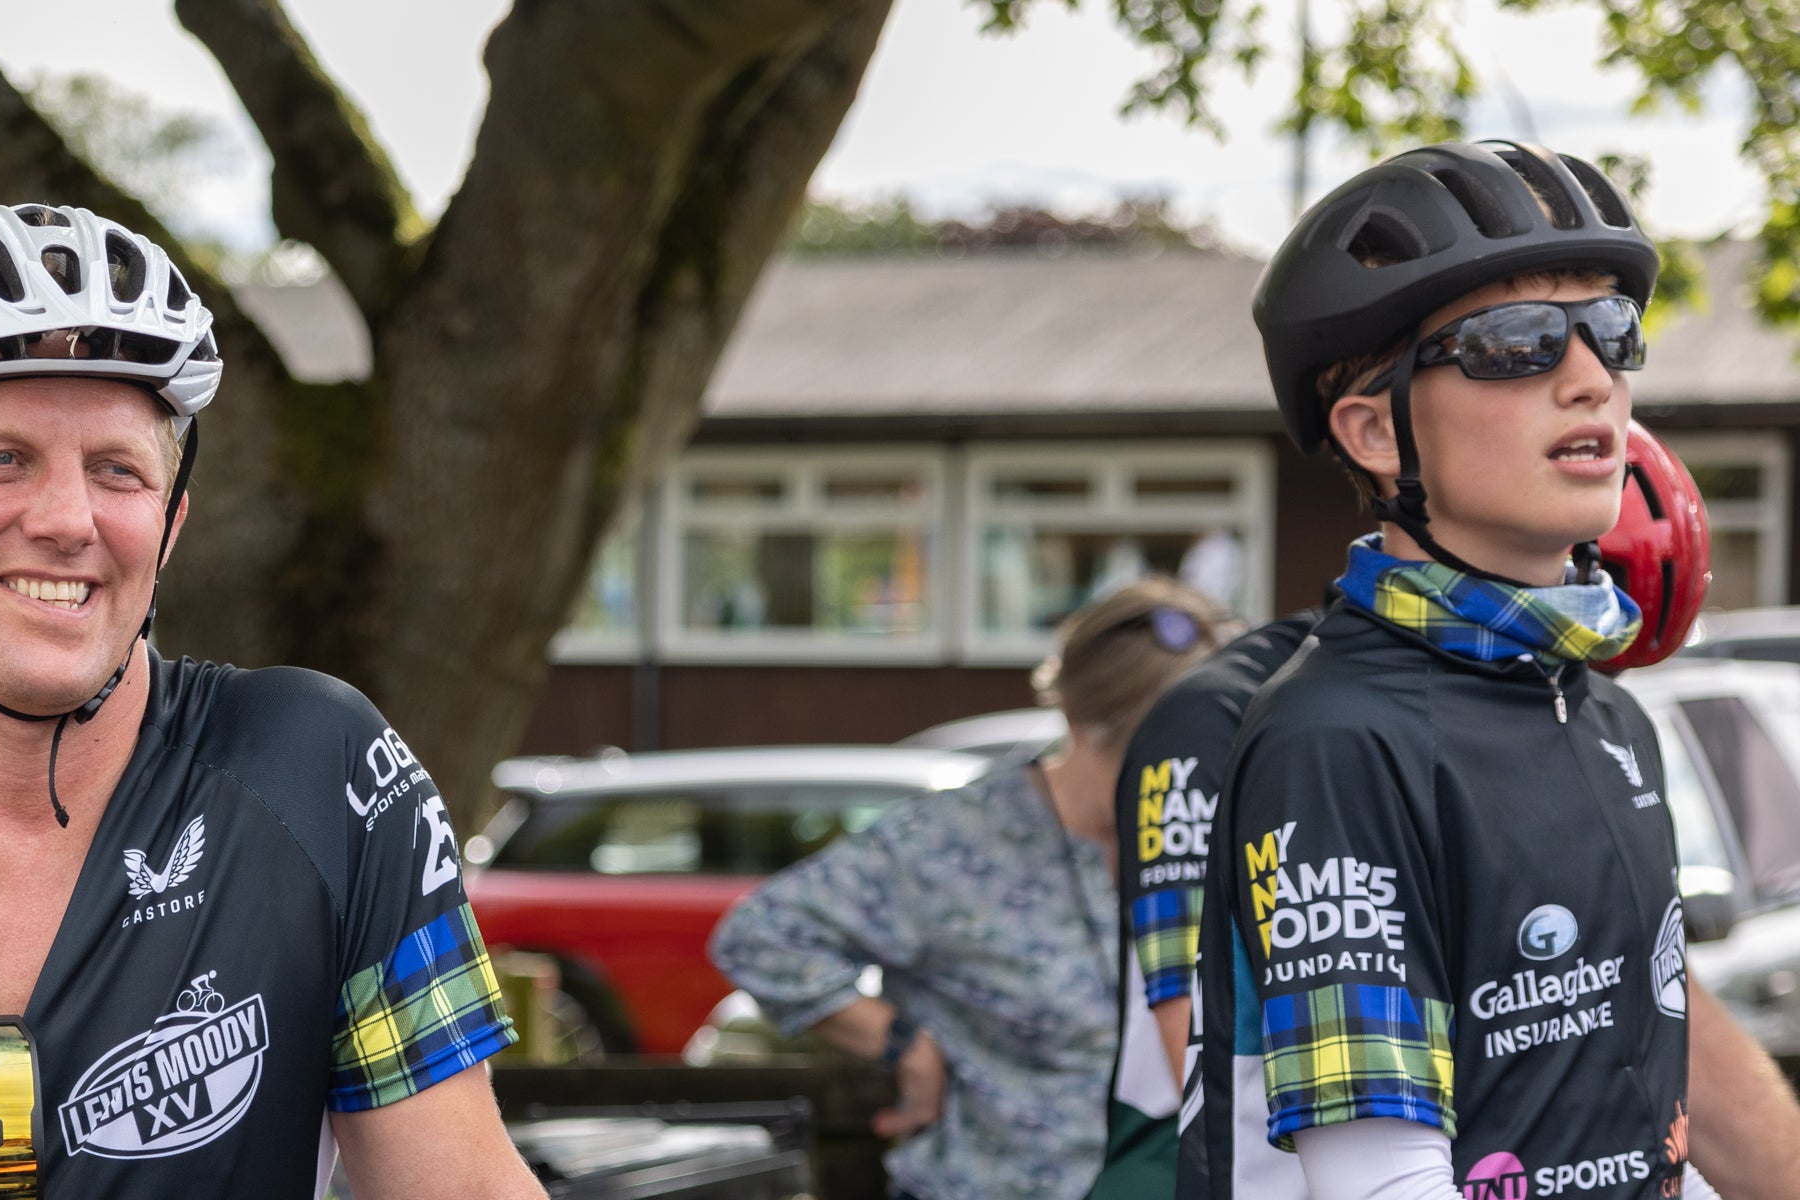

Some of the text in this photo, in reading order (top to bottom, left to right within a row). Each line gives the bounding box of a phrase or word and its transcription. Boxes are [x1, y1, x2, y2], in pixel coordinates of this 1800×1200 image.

[1140, 757, 1199, 798] MY
[1245, 821, 1298, 881] MY
[1469, 954, 1625, 1021] Gallagher
[153, 1003, 259, 1090] MOODY
[1484, 1000, 1614, 1059] INSURANCE
[143, 1086, 197, 1137] XV
[1535, 1150, 1650, 1197] SPORTS
